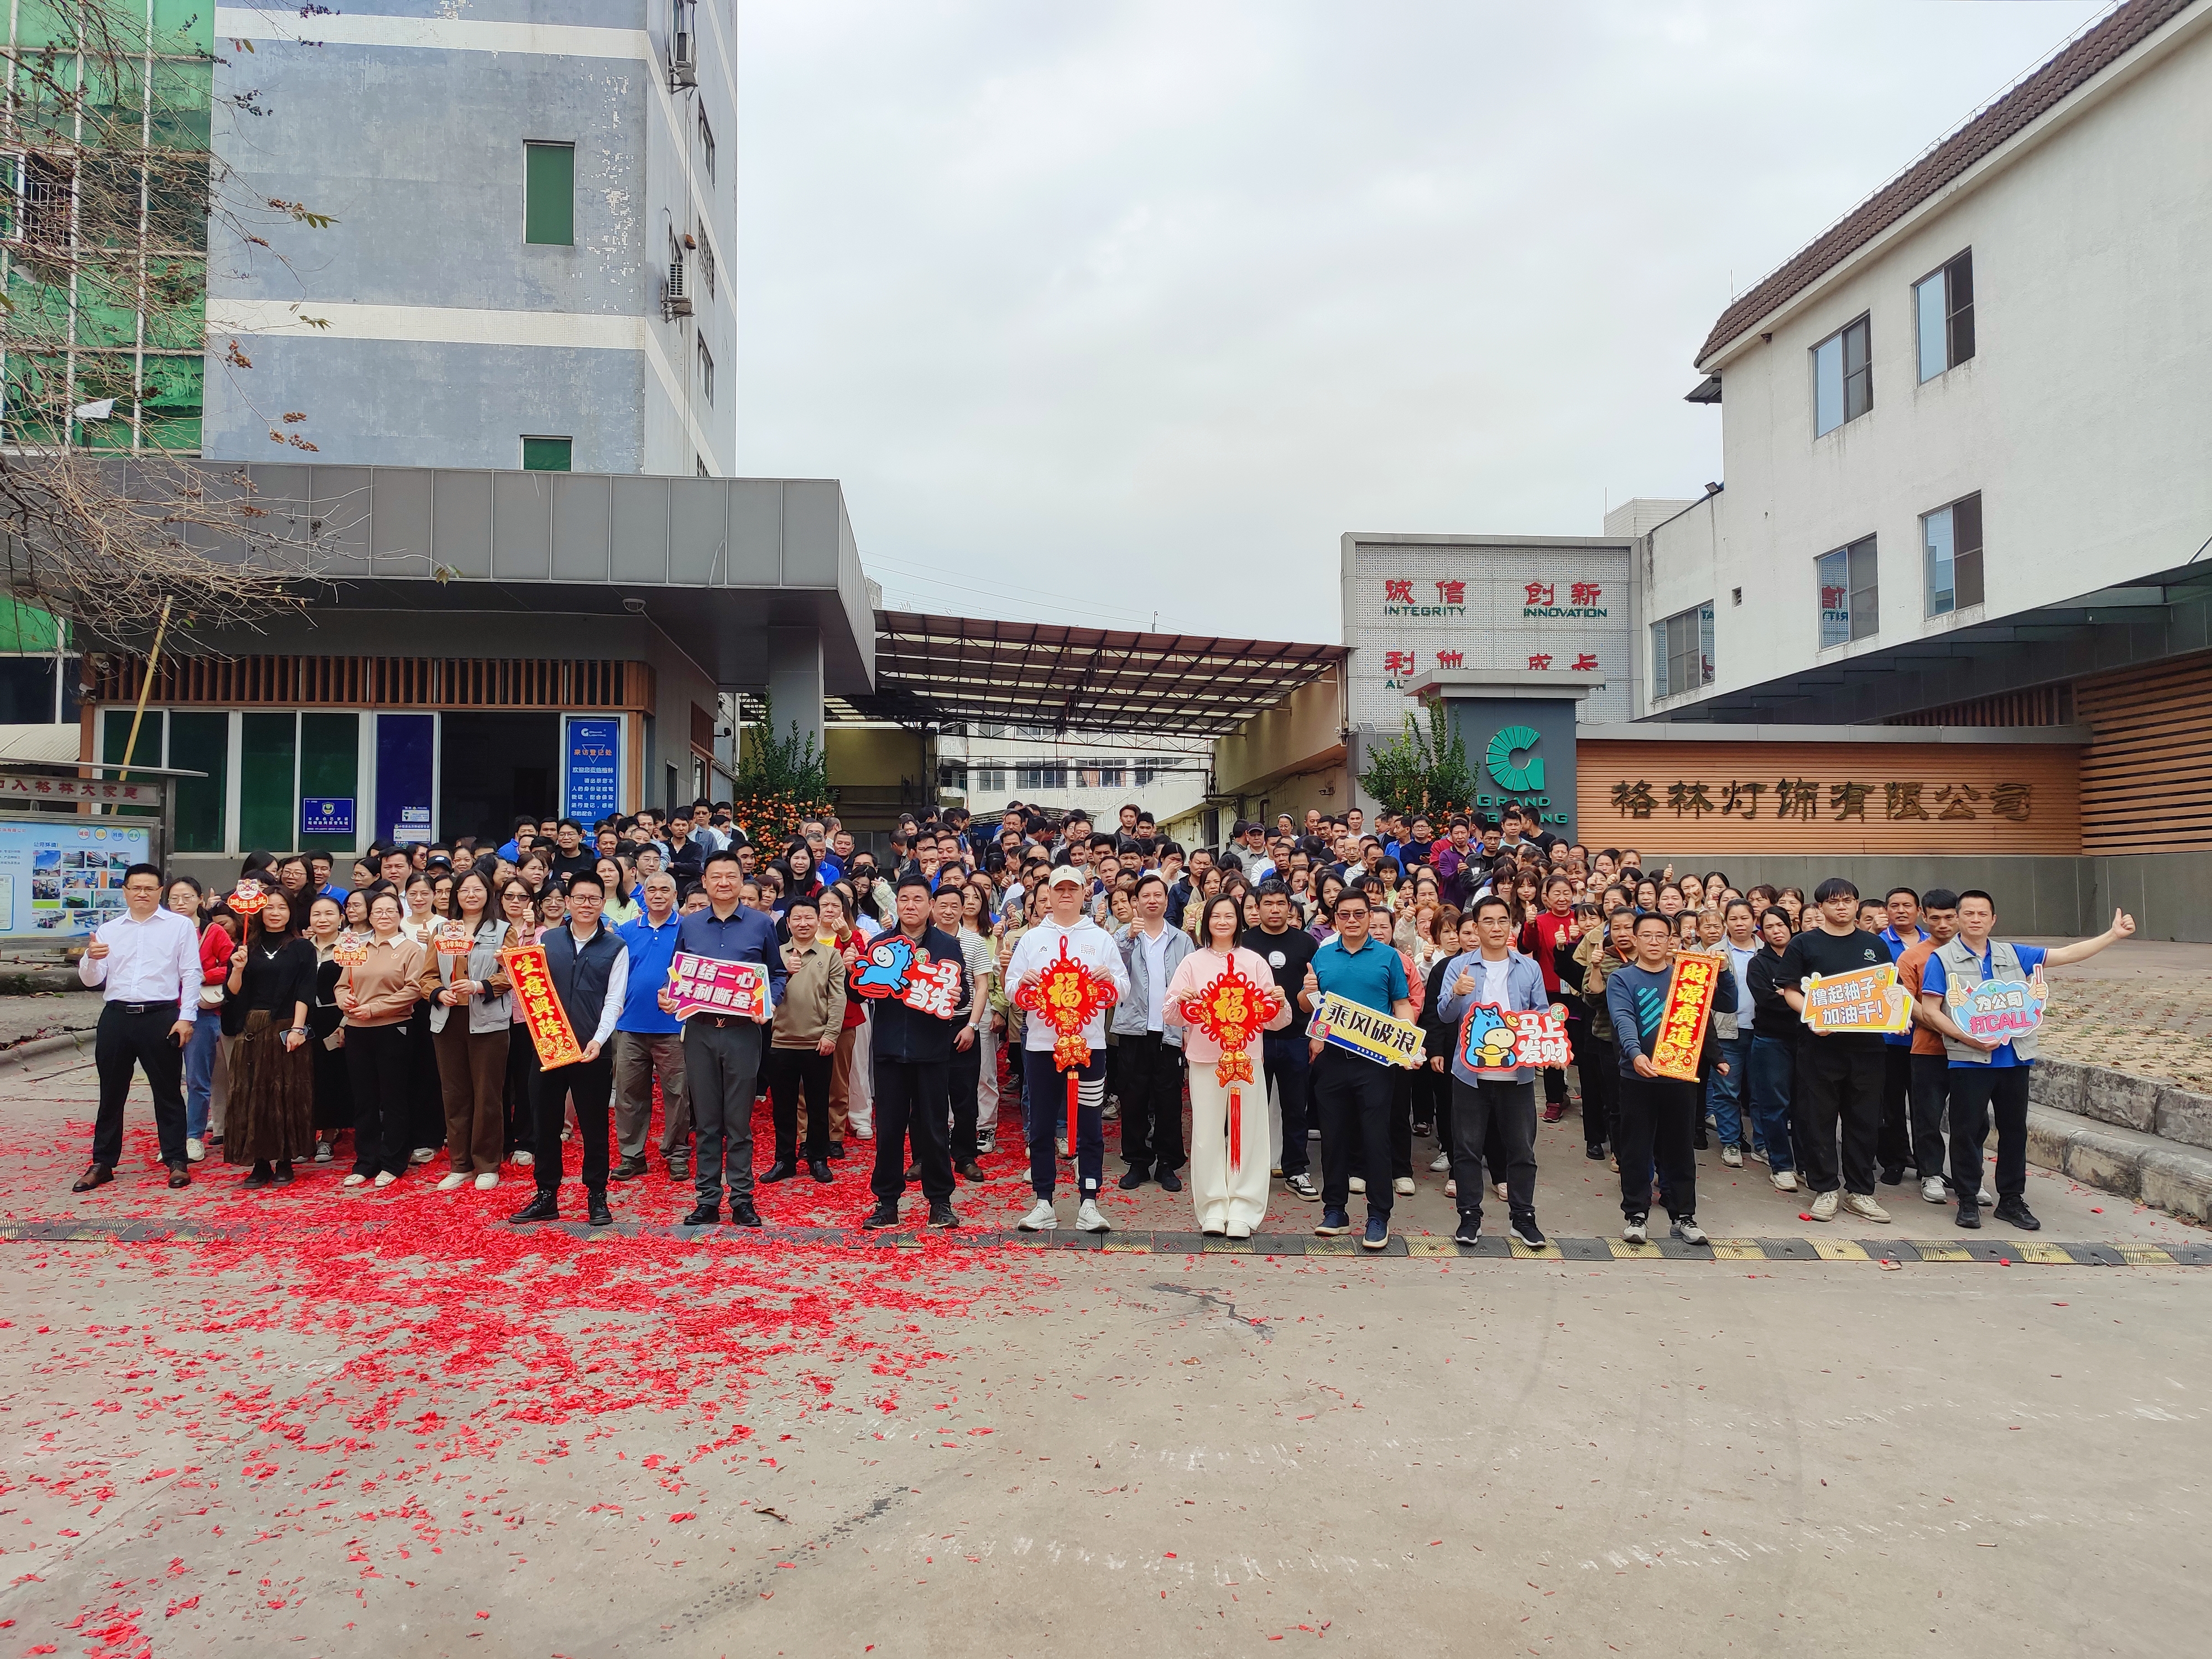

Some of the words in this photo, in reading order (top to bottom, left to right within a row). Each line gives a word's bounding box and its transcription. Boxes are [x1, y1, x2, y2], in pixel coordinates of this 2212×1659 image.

[1384, 606, 1466, 616] INTEGRITY
[1524, 608, 1608, 617] INNOVATION
[1611, 778, 2032, 821] 格林灯饰有限公司
[679, 958, 755, 989] 团结一心
[674, 979, 752, 1010] 其利断金
[1047, 973, 1082, 1008] 福
[1213, 987, 1248, 1022] 福
[1812, 975, 1876, 1006] 撸起袖子
[1975, 991, 2023, 1013] 为公司
[1326, 1001, 1417, 1055] 乘风破浪
[1516, 1013, 1565, 1040] 马上
[1969, 1010, 2033, 1035] 打CALL
[1517, 1037, 1568, 1064] 发财
